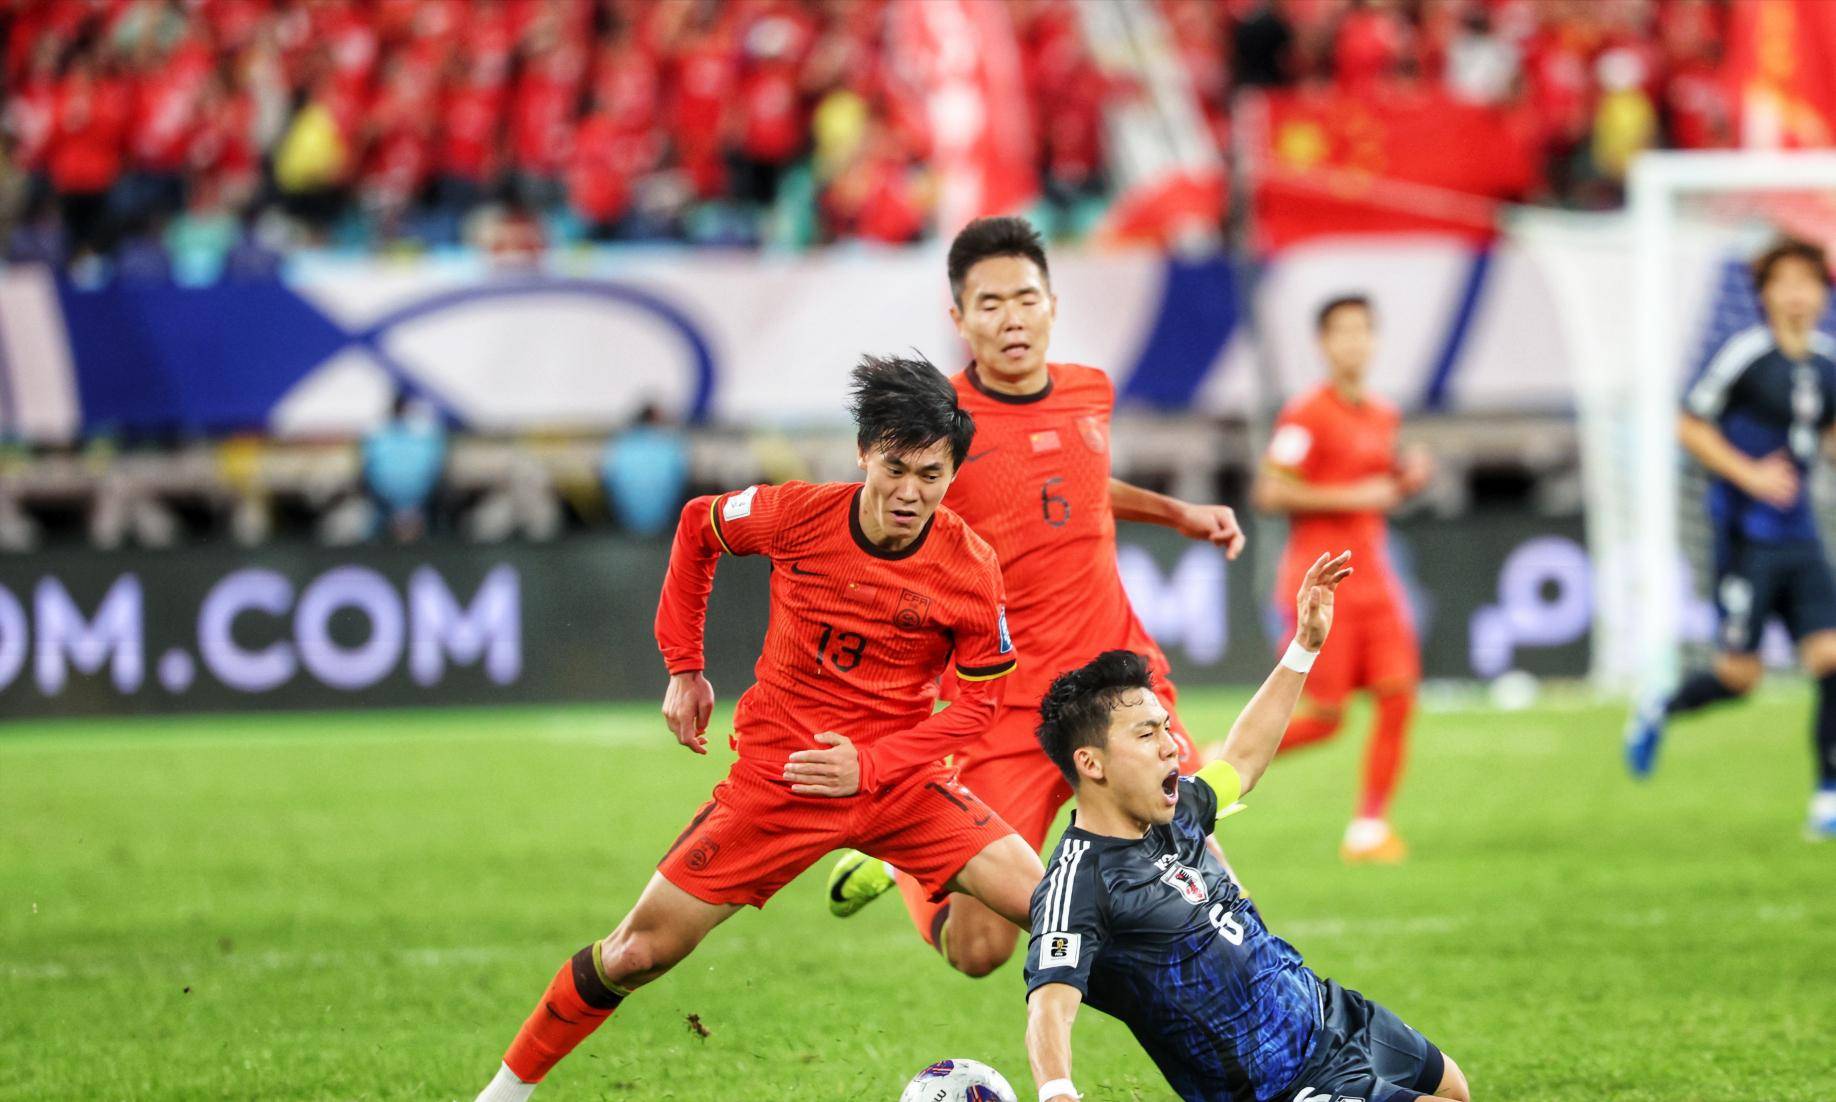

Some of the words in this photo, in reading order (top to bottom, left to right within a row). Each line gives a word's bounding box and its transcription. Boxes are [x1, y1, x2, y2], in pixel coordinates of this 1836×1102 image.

[1041, 475, 1071, 528] 6
[0, 562, 524, 695] M.COM
[815, 621, 867, 673] 13
[1208, 902, 1245, 946] 6
